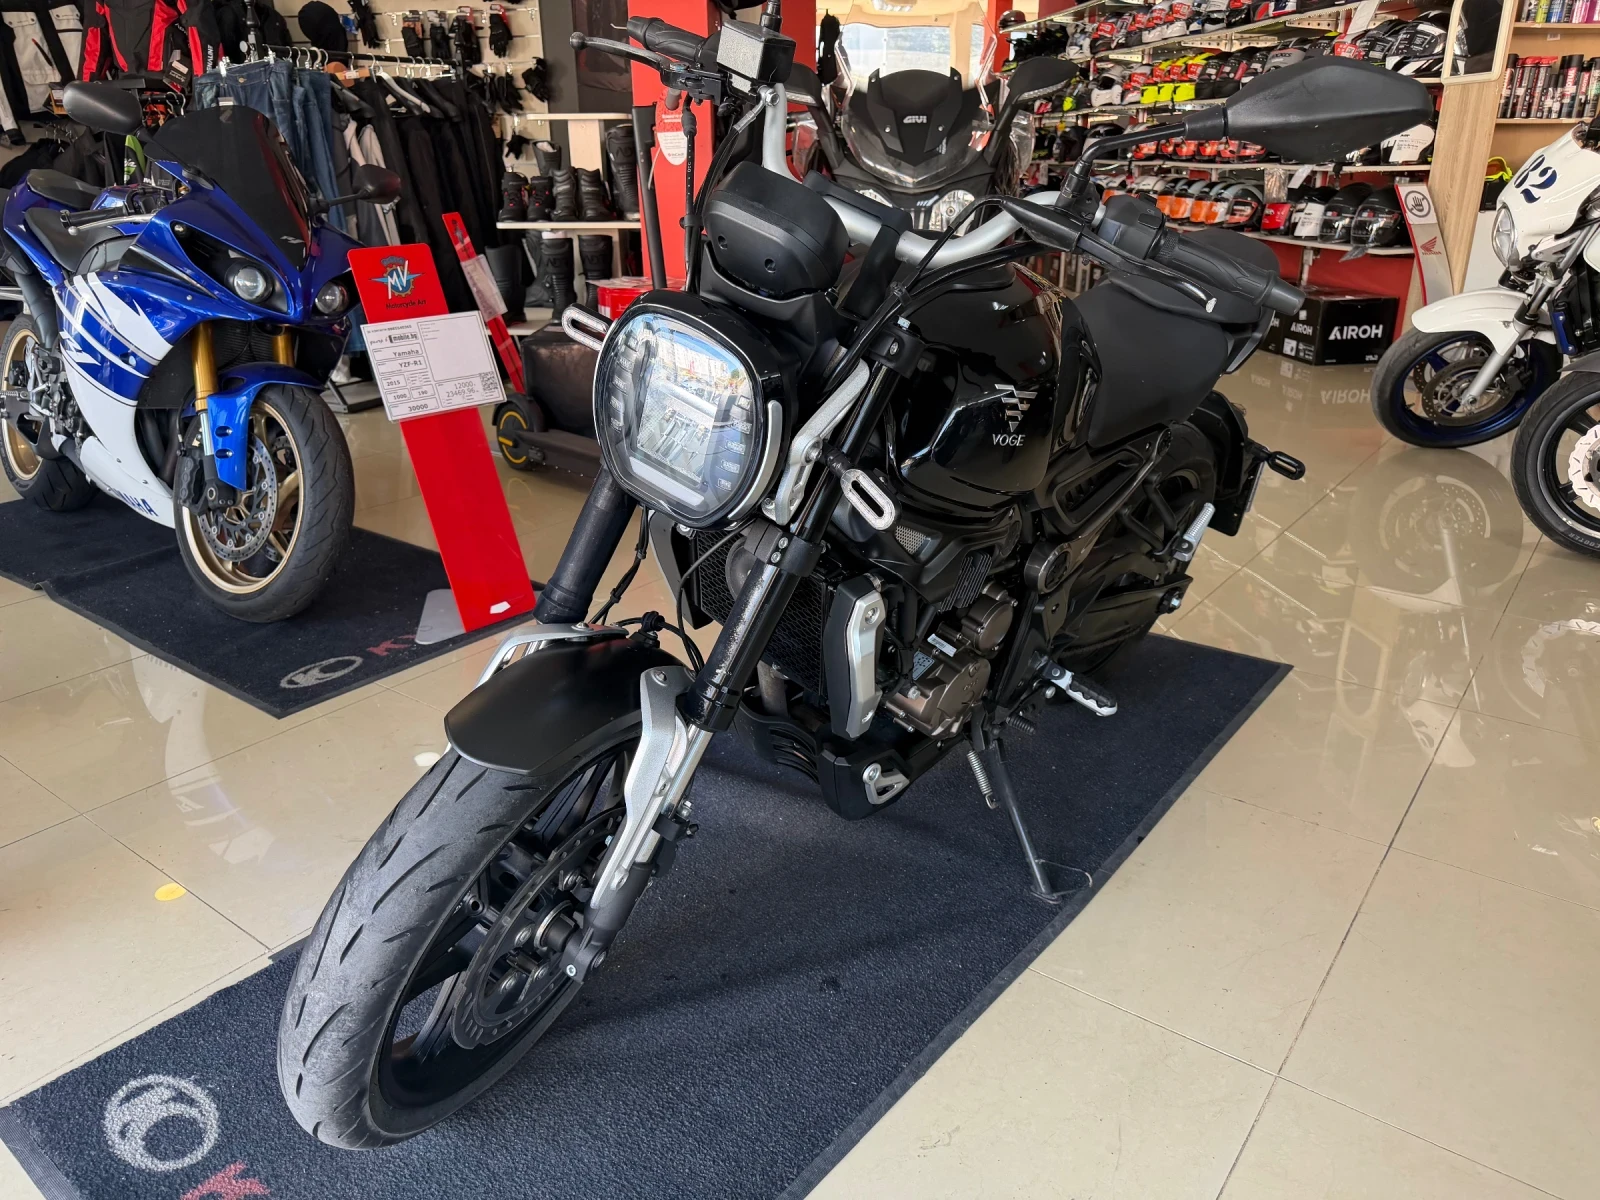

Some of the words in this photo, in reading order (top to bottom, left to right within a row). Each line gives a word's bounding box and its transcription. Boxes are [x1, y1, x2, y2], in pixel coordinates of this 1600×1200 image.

[903, 115, 927, 124] GIVI
[1513, 154, 1557, 203] 82
[385, 301, 416, 309] Motorcycle
[1290, 321, 1313, 336] AIROH
[1328, 324, 1384, 341] AIROH
[392, 333, 418, 341] mobile.bg
[392, 349, 420, 357] Yamaha
[398, 360, 423, 368] YZF-R1
[407, 403, 429, 412] 30000
[992, 433, 1026, 447] VOGE
